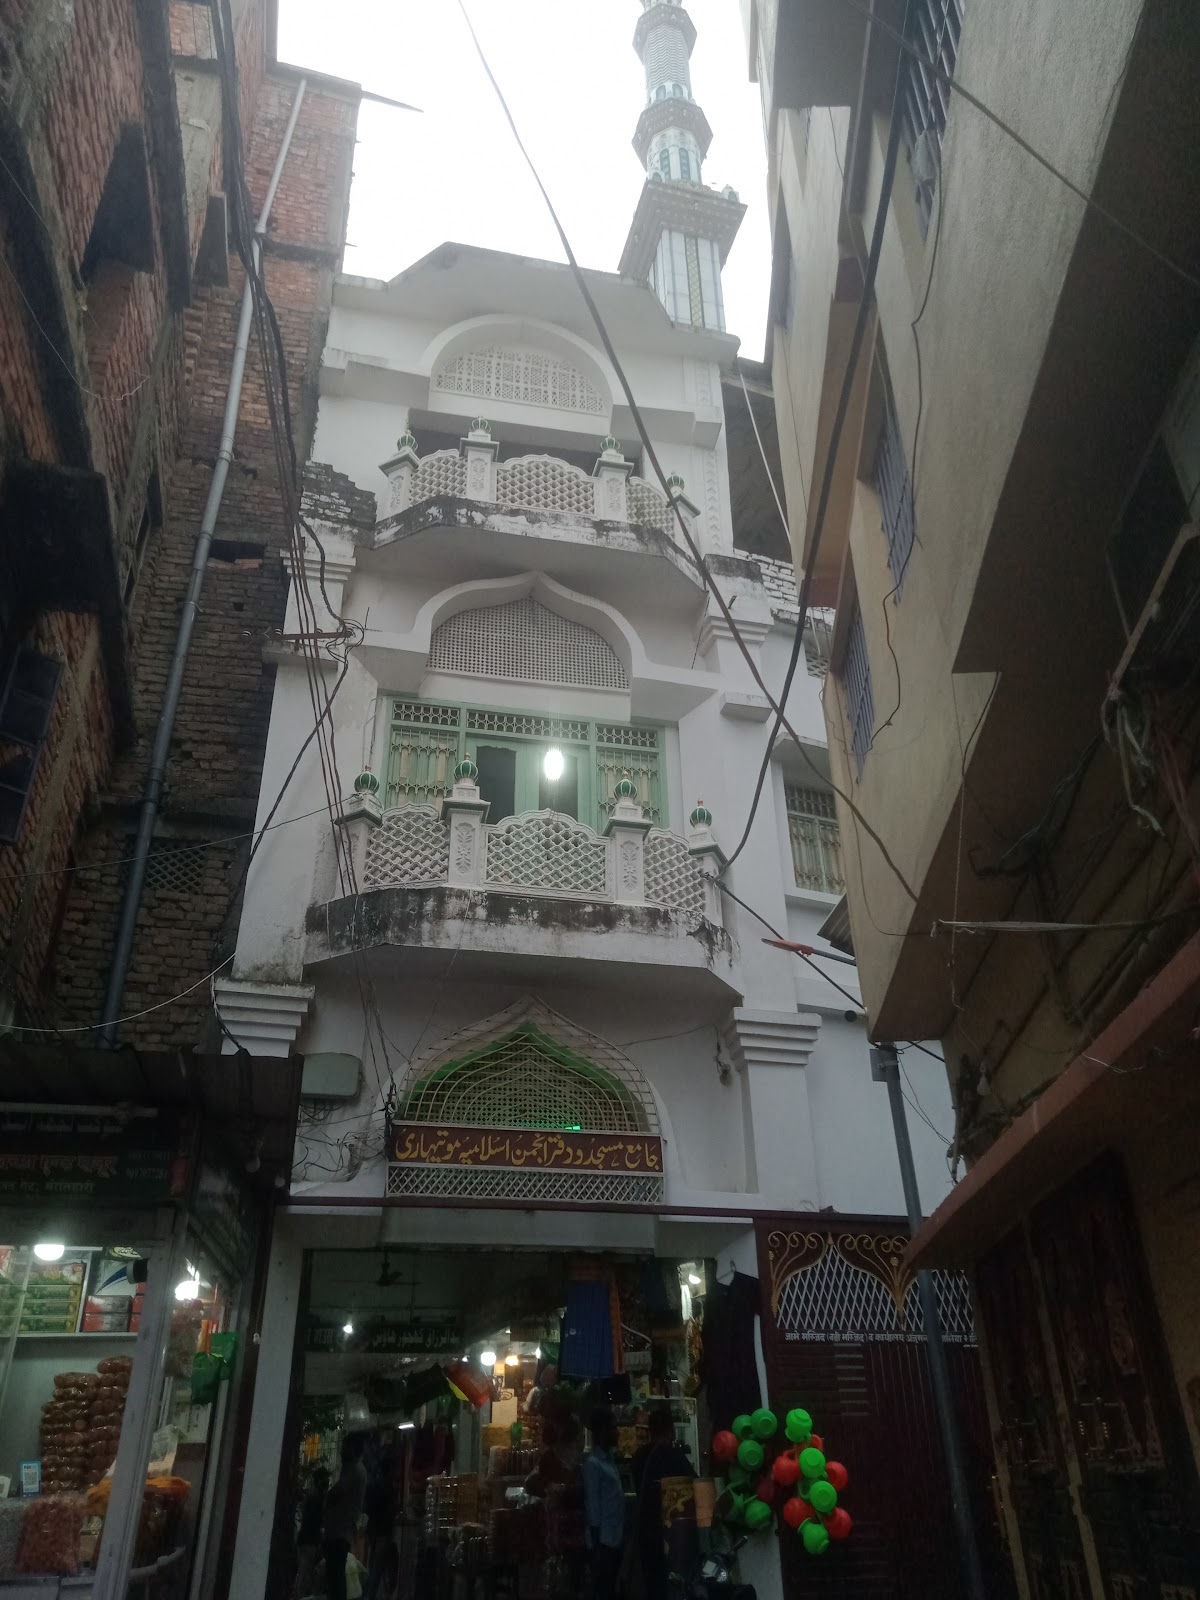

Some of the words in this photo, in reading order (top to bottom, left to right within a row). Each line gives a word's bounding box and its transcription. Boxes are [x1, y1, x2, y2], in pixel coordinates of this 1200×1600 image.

[459, 1135, 510, 1165] اسلامیہ
[511, 1133, 548, 1168] انجمن
[544, 1134, 574, 1166] دفتر
[582, 1139, 624, 1169] مسجد
[624, 1142, 660, 1170] جامع
[802, 1330, 826, 1342] मस्जिद
